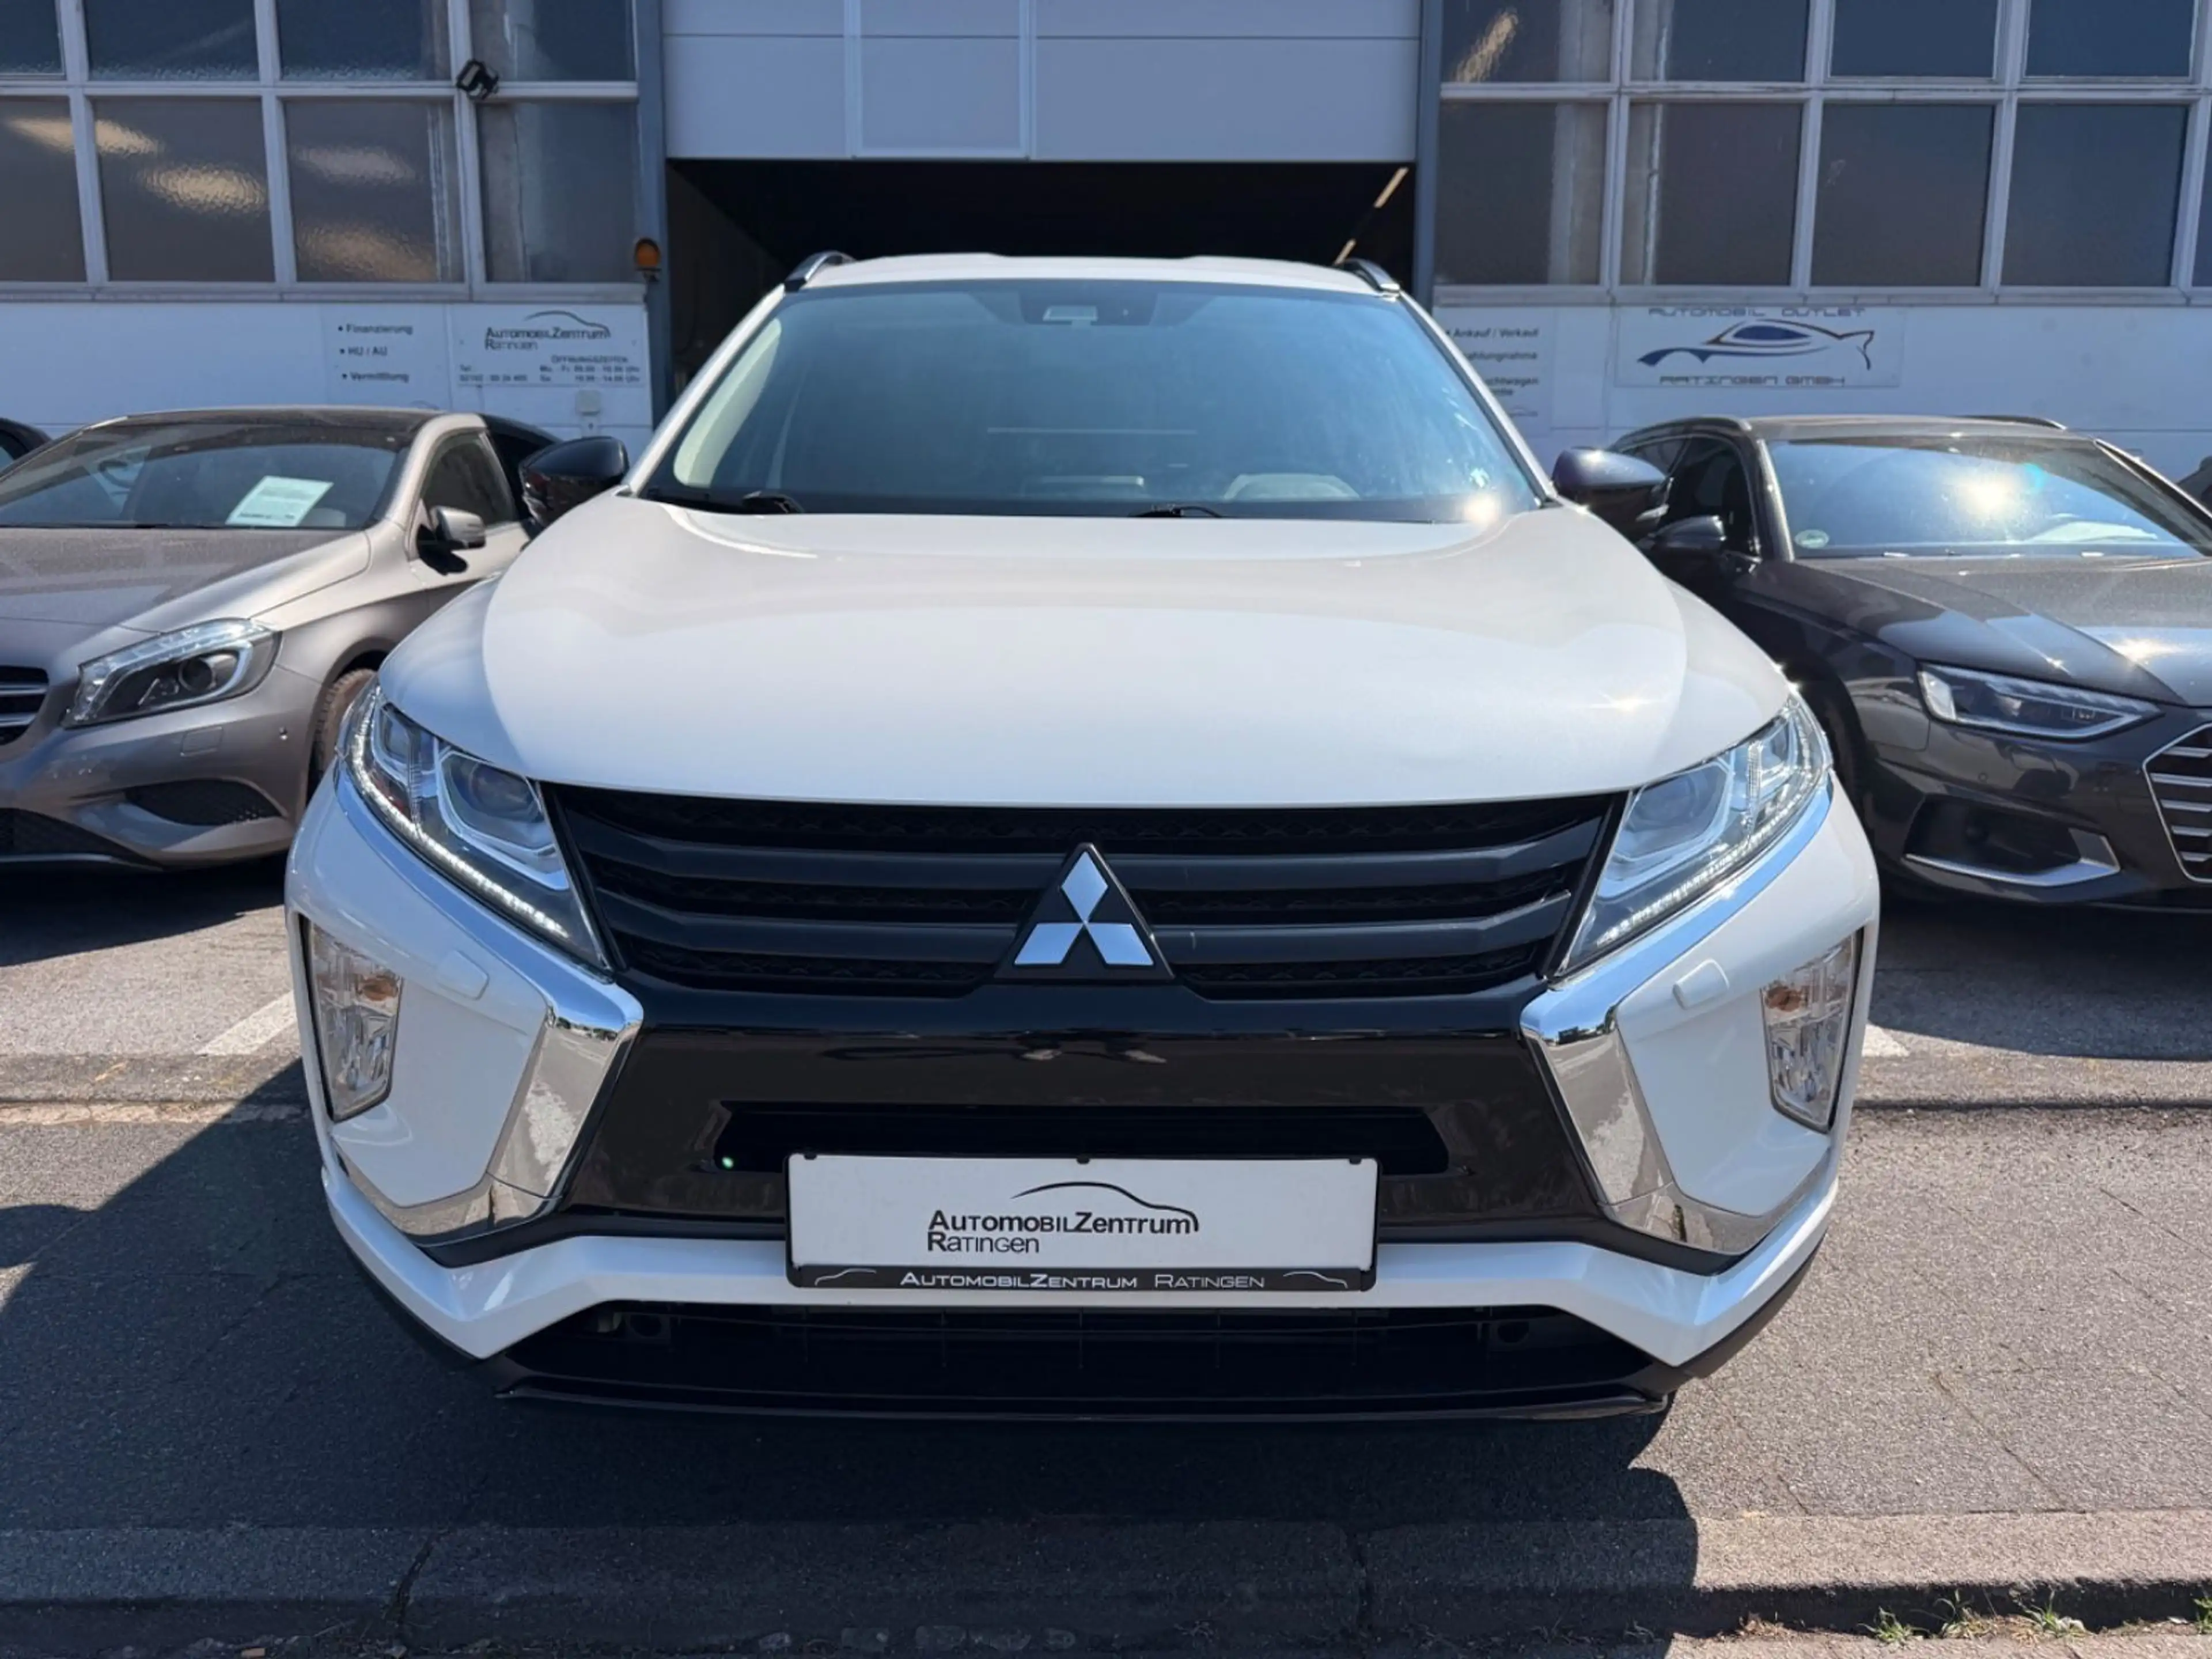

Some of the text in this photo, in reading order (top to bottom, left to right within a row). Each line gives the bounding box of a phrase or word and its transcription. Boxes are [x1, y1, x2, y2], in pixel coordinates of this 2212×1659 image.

[1648, 308, 1865, 317] AUTOMOBIL OUTLET
[1660, 376, 1778, 385] RATINGEN
